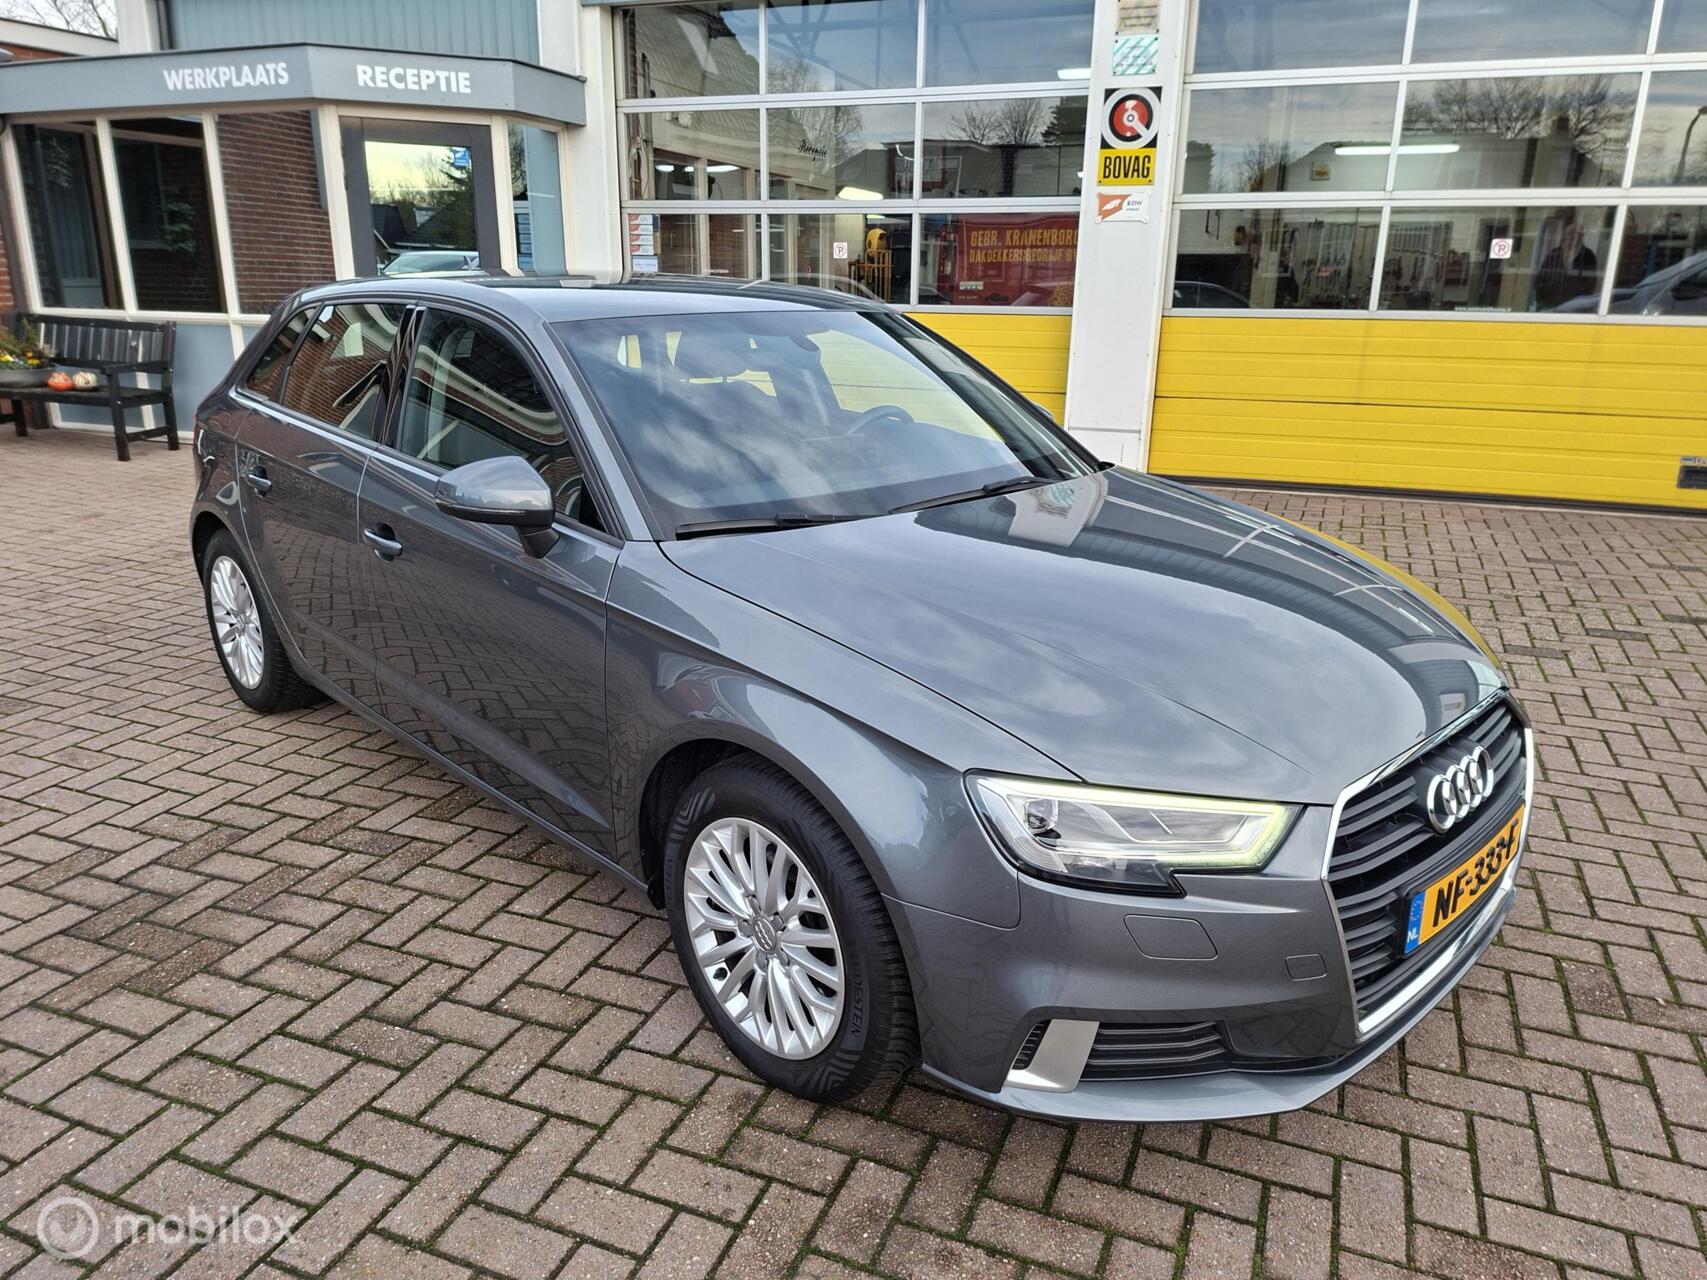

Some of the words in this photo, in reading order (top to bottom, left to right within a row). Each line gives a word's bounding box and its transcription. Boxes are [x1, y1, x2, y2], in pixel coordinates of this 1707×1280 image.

[163, 62, 290, 91] WERKPLAATS
[356, 65, 472, 94] RECEPTIE
[1103, 155, 1151, 179] BOVAG
[970, 230, 1002, 247] GEBR.
[1407, 927, 1418, 943] NL
